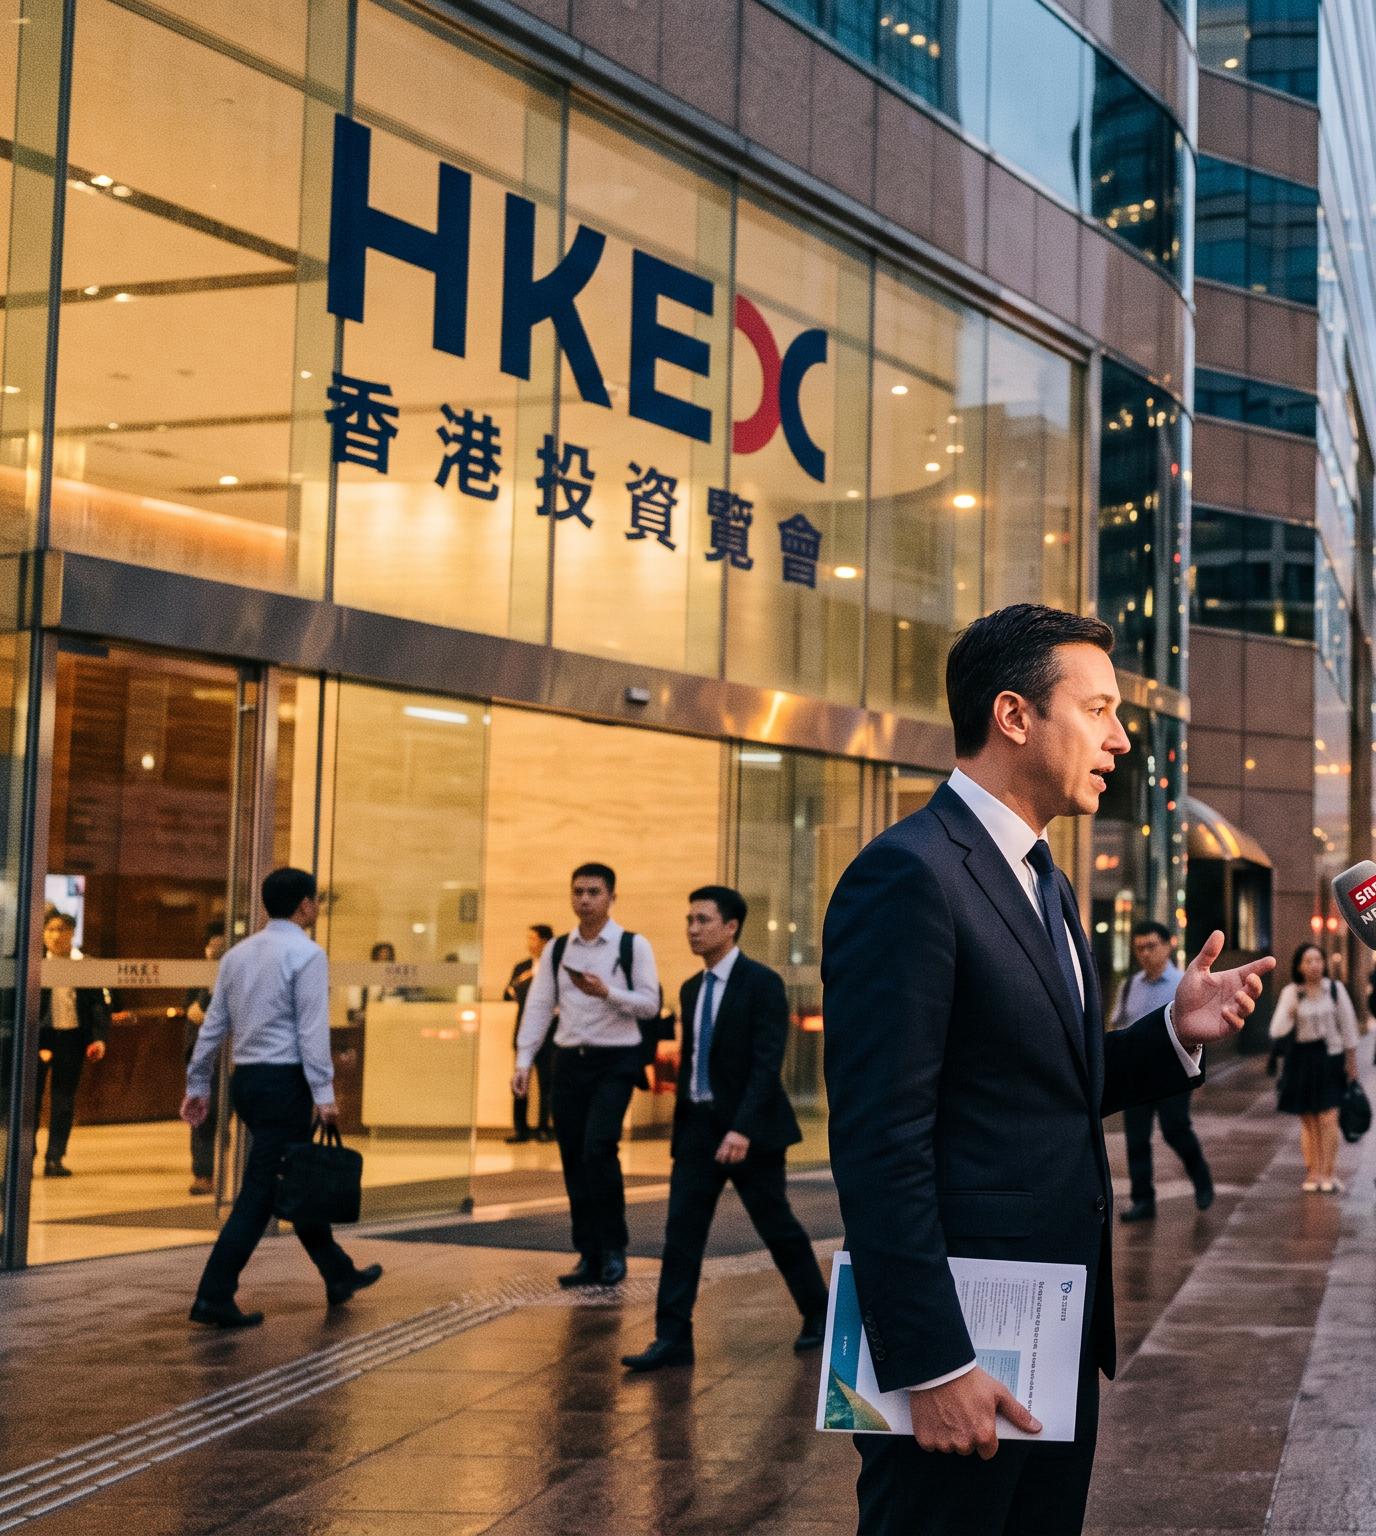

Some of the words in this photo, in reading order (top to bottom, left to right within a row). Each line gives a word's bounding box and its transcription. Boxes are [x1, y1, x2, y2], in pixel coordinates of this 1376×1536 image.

[325, 372, 822, 589] 香港投資覽會
